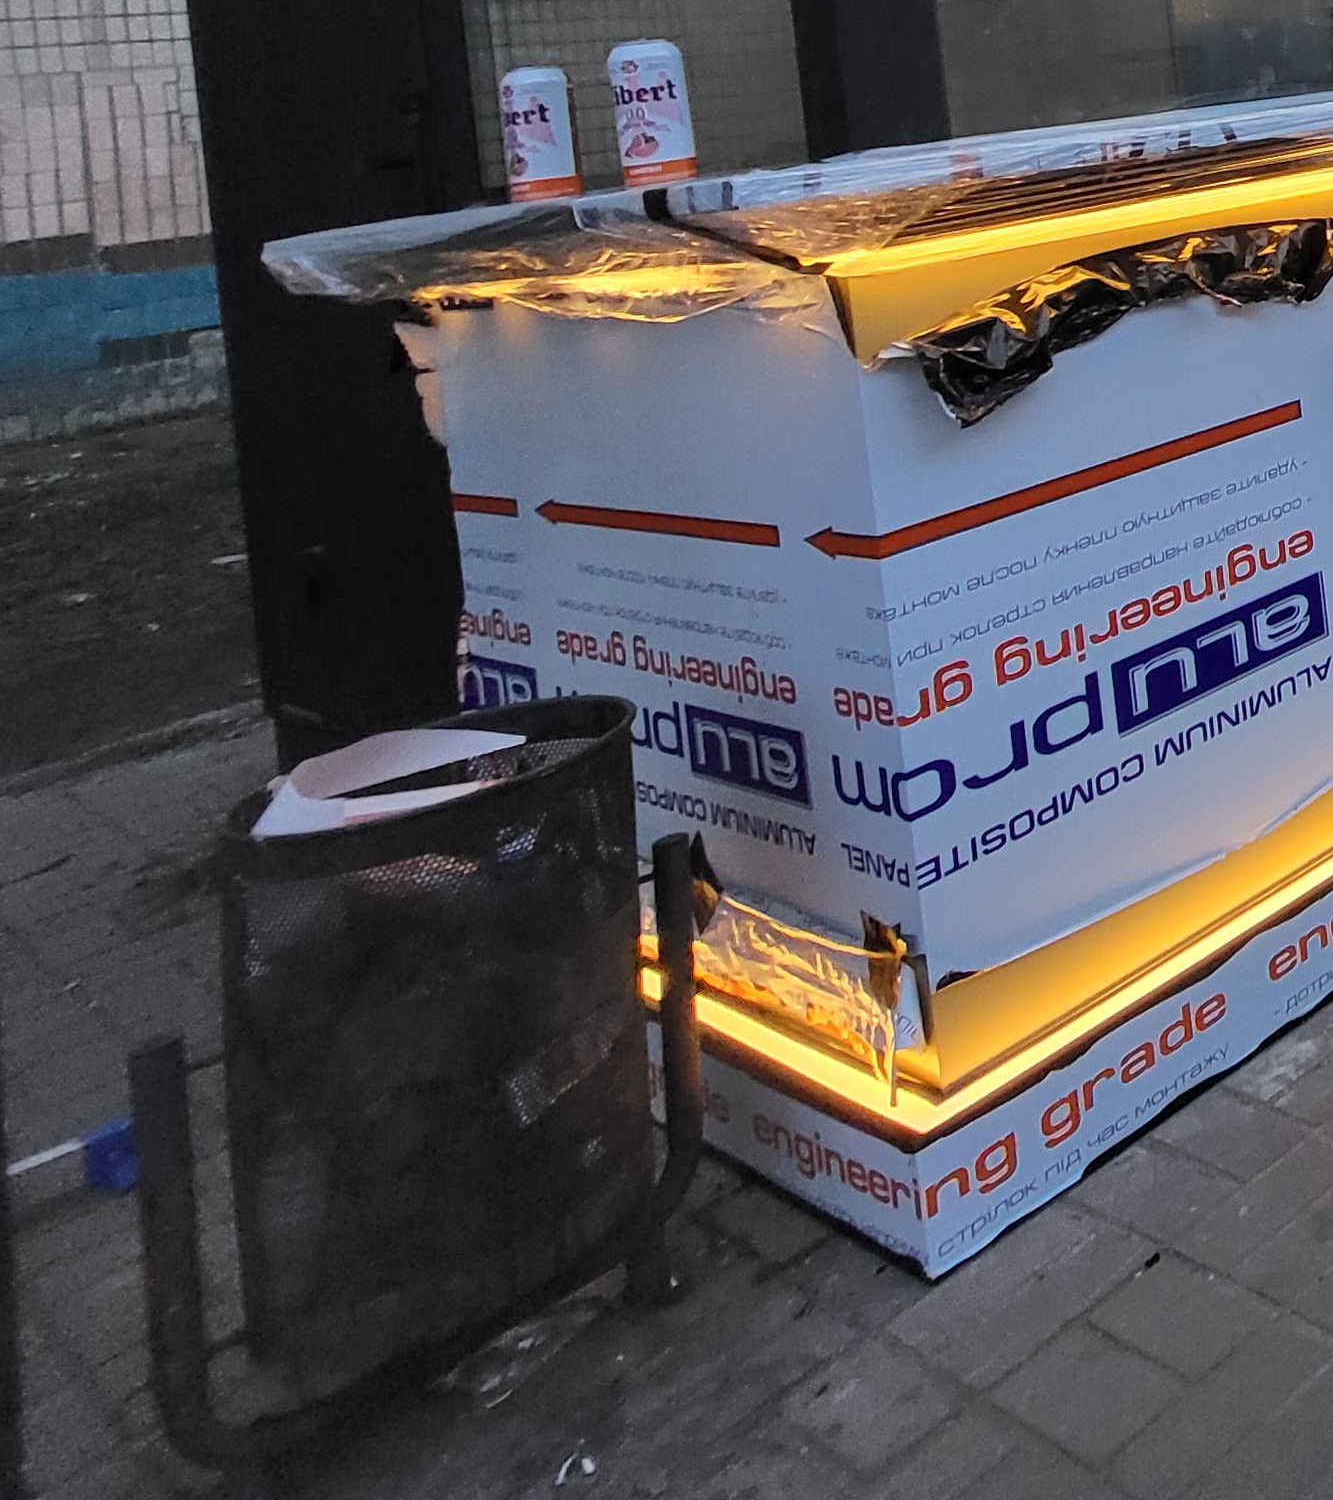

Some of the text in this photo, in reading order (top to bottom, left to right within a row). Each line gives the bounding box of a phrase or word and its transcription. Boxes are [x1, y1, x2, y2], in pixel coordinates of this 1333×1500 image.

[1226, 457, 1298, 493] удалите
[1123, 488, 1222, 534] защитную
[1192, 498, 1303, 550] соблюдайте
[1044, 526, 1118, 561] пленку
[966, 556, 1037, 592] после
[1052, 541, 1189, 606] направления
[834, 530, 1314, 731] engineering grade
[950, 599, 1046, 647] стрелок
[557, 630, 796, 705] engineering grade
[896, 640, 944, 668] при
[840, 657, 1332, 890] ALUMINIUM COMPOSITE PANEL
[637, 781, 816, 856] ALUMINIUM COMPOS
[754, 990, 1228, 1221] engineering grade
[937, 1179, 1039, 1258] стрілок
[1044, 1146, 1082, 1186] під
[1087, 1115, 1130, 1147] час
[1134, 1043, 1230, 1121] монтажу
